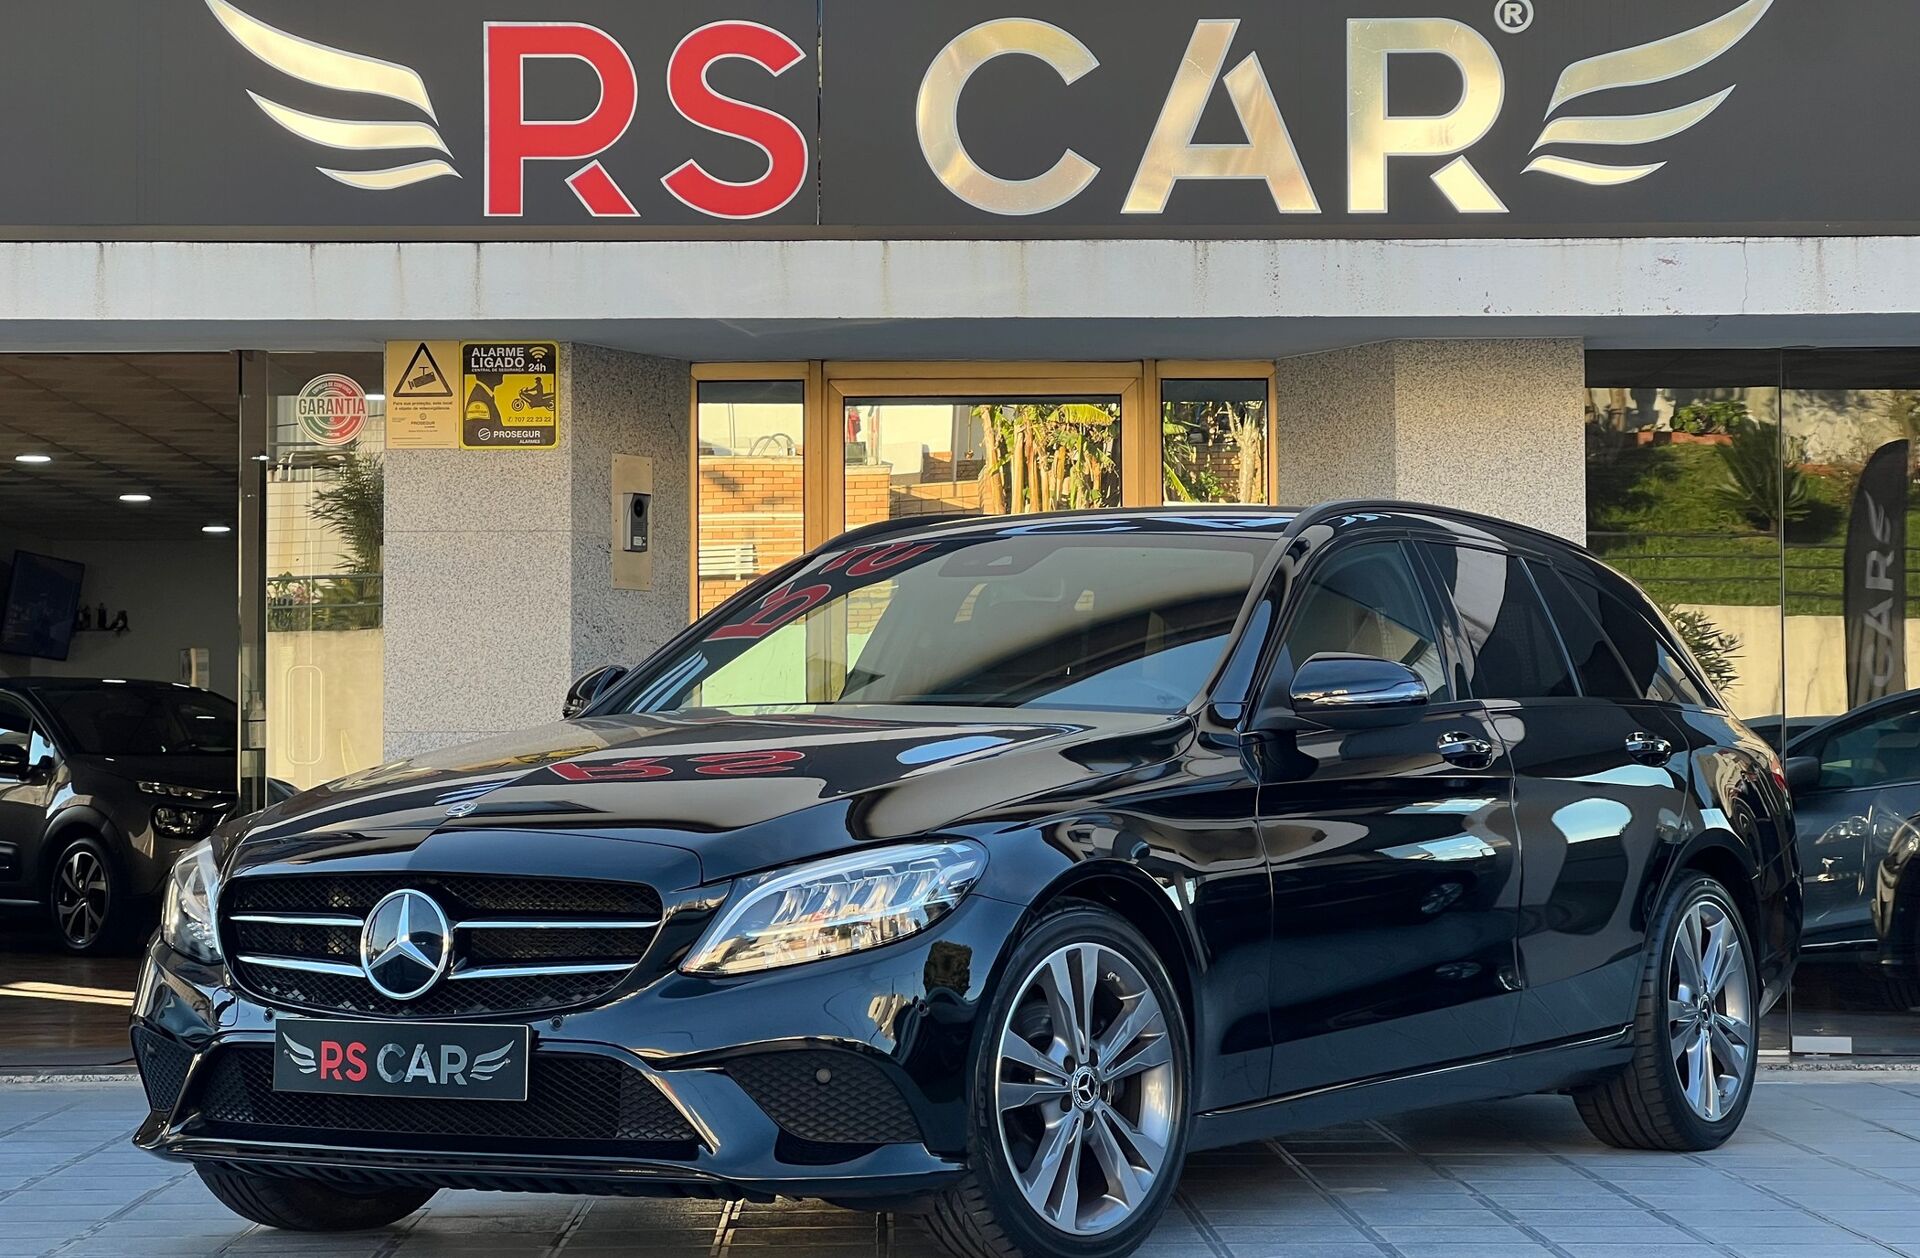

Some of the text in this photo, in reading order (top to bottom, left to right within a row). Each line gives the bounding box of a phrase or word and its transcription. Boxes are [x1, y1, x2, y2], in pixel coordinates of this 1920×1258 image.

[484, 20, 808, 219] RS
[915, 17, 1509, 215] CAR
[471, 347, 547, 372] ALARME 24h
[471, 357, 525, 368] LIGADO
[299, 398, 366, 415] GARANTIA
[493, 430, 541, 438] PROSEGUR
[320, 1040, 468, 1086] RS CAR
